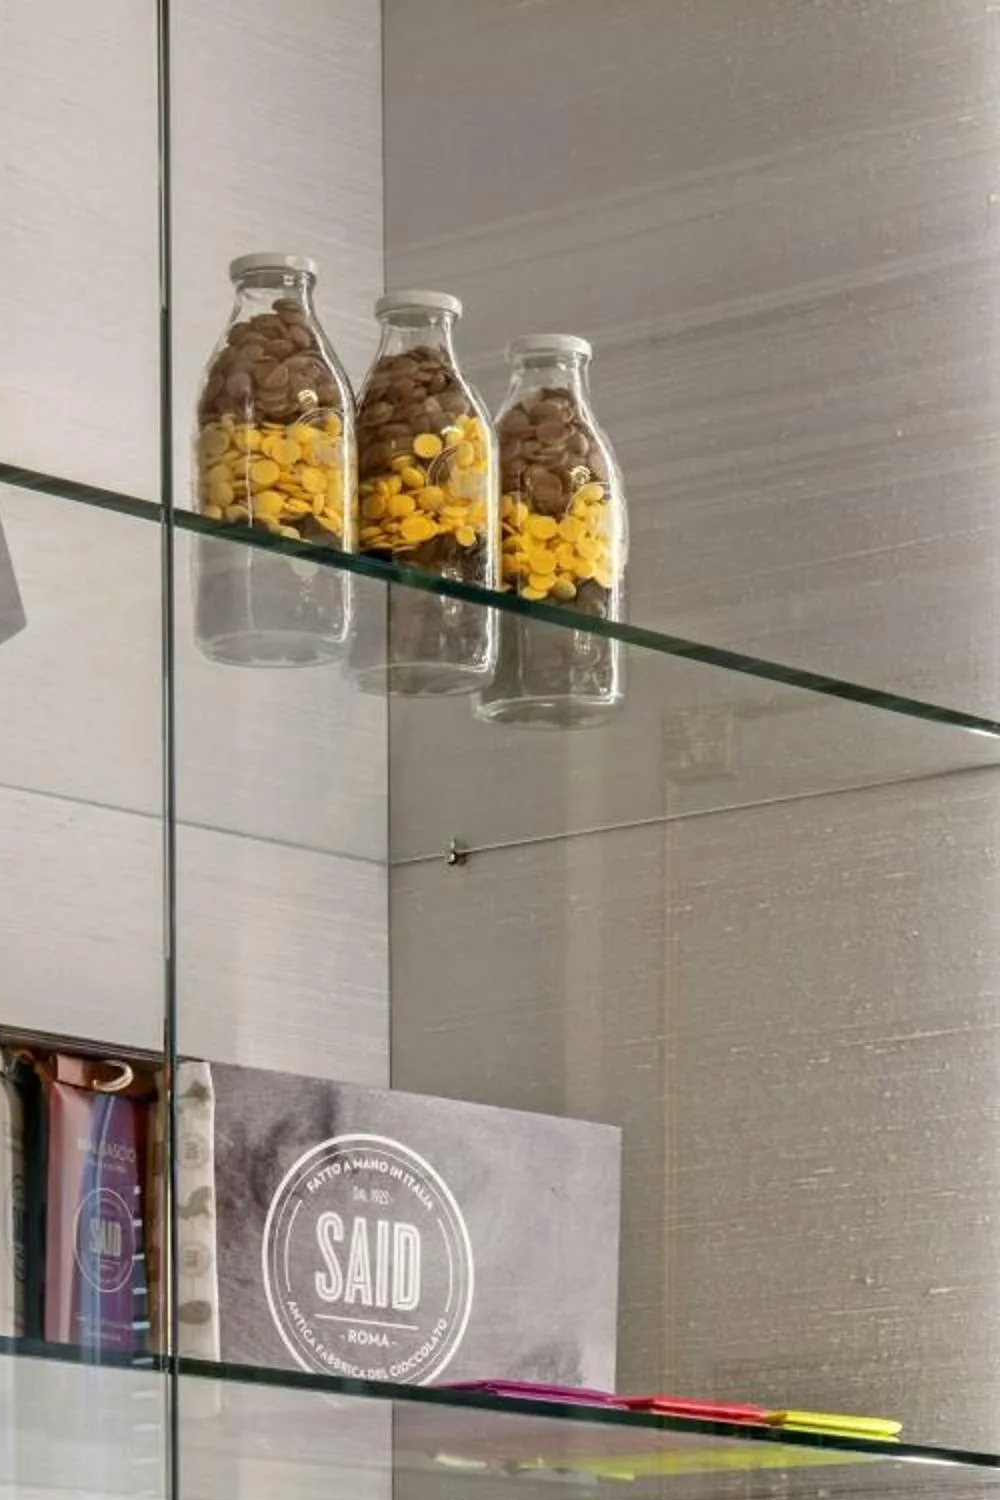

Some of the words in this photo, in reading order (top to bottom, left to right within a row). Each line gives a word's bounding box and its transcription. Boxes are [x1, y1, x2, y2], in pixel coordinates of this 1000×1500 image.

[306, 1162, 341, 1193] FATTO
[344, 1160, 352, 1173] A
[353, 1157, 389, 1173] MANO
[389, 1165, 403, 1180] IN
[402, 1174, 433, 1212] ITALIA
[89, 1216, 123, 1258] SAID
[314, 1211, 421, 1311] SAID
[287, 1301, 316, 1347] ANTICA
[389, 1318, 448, 1378] CIOCCOLATO
[347, 1329, 391, 1349] ROMA
